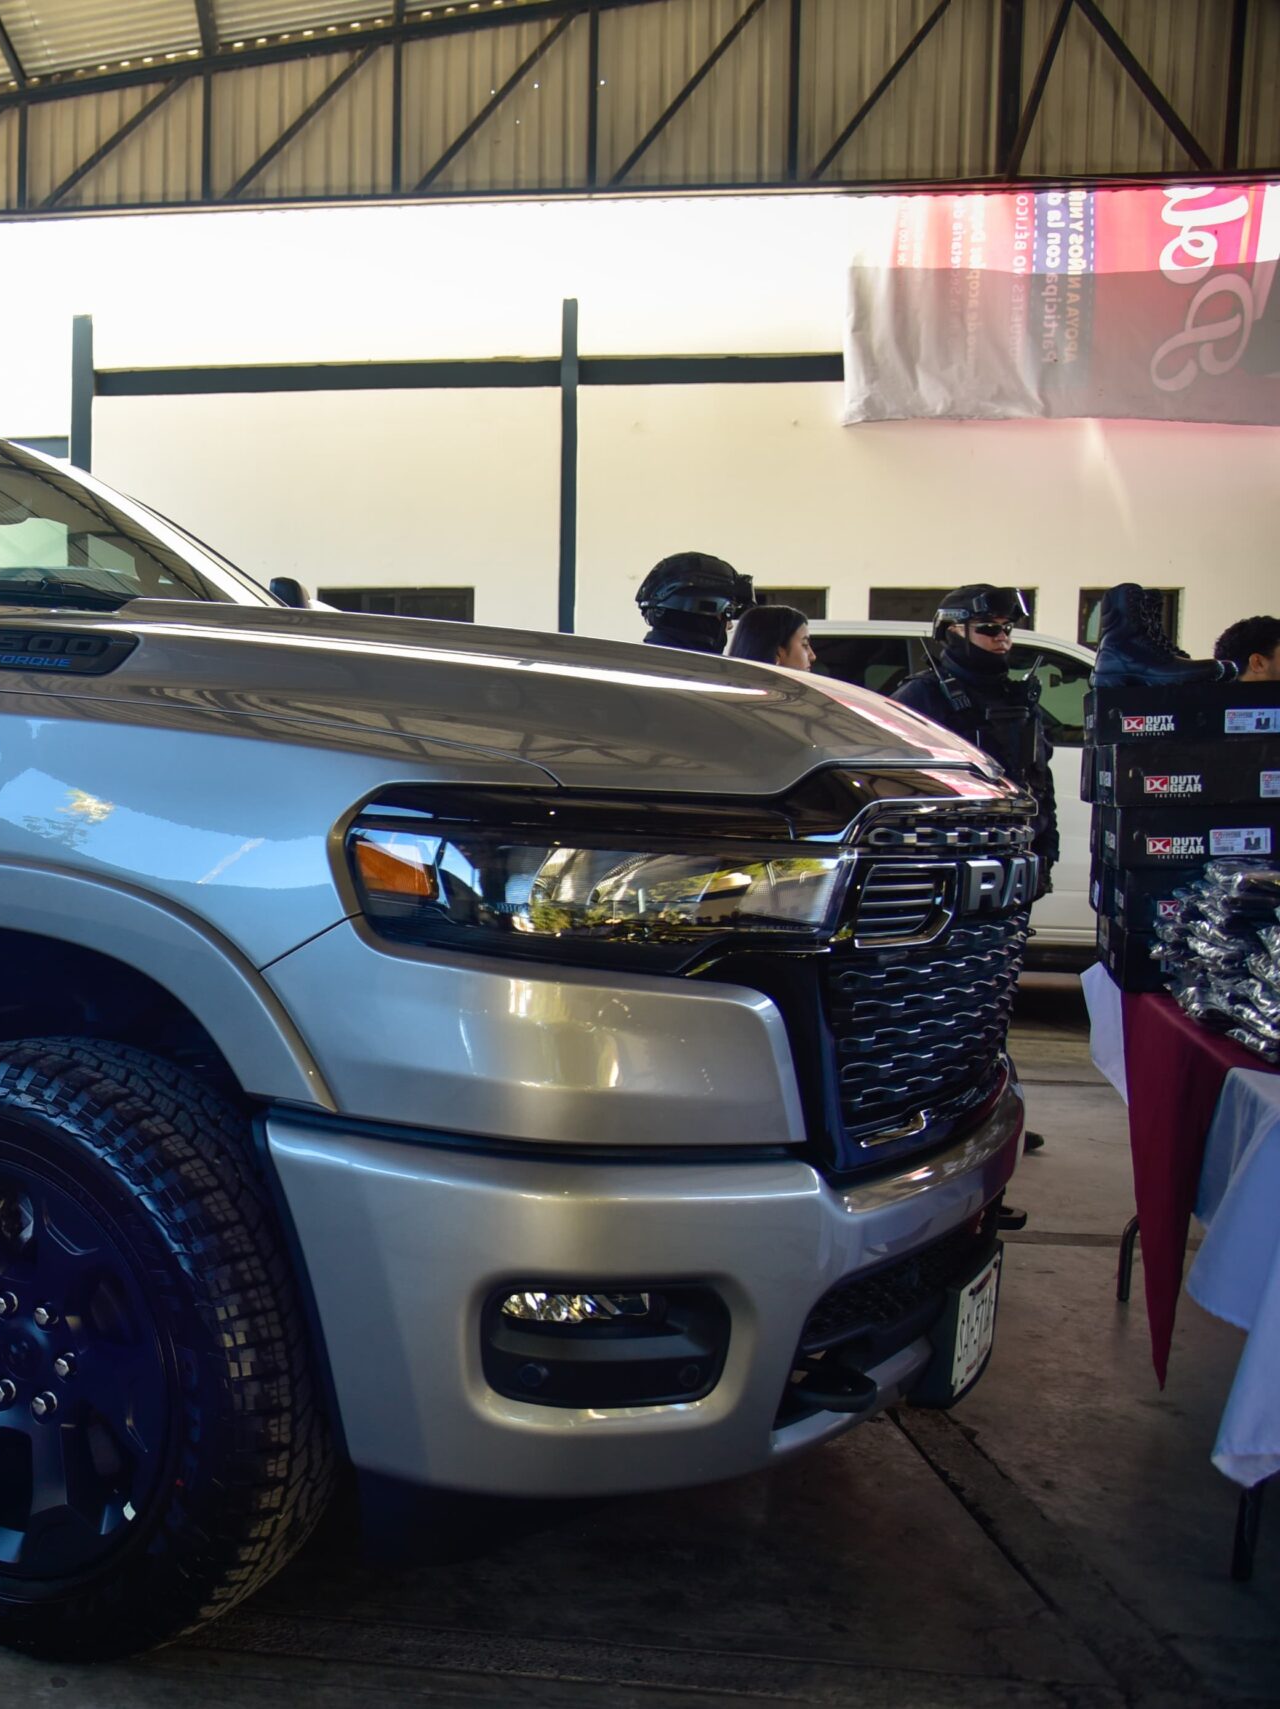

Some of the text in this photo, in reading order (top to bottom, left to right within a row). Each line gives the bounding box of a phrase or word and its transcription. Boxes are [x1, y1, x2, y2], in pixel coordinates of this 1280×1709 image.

[1145, 715, 1174, 724] DUTY
[1145, 723, 1175, 732] GEAR
[1170, 775, 1200, 784] DUTY
[1169, 783, 1202, 793] GEAR
[1172, 836, 1203, 846] DUTY
[1172, 845, 1205, 854] GEAR
